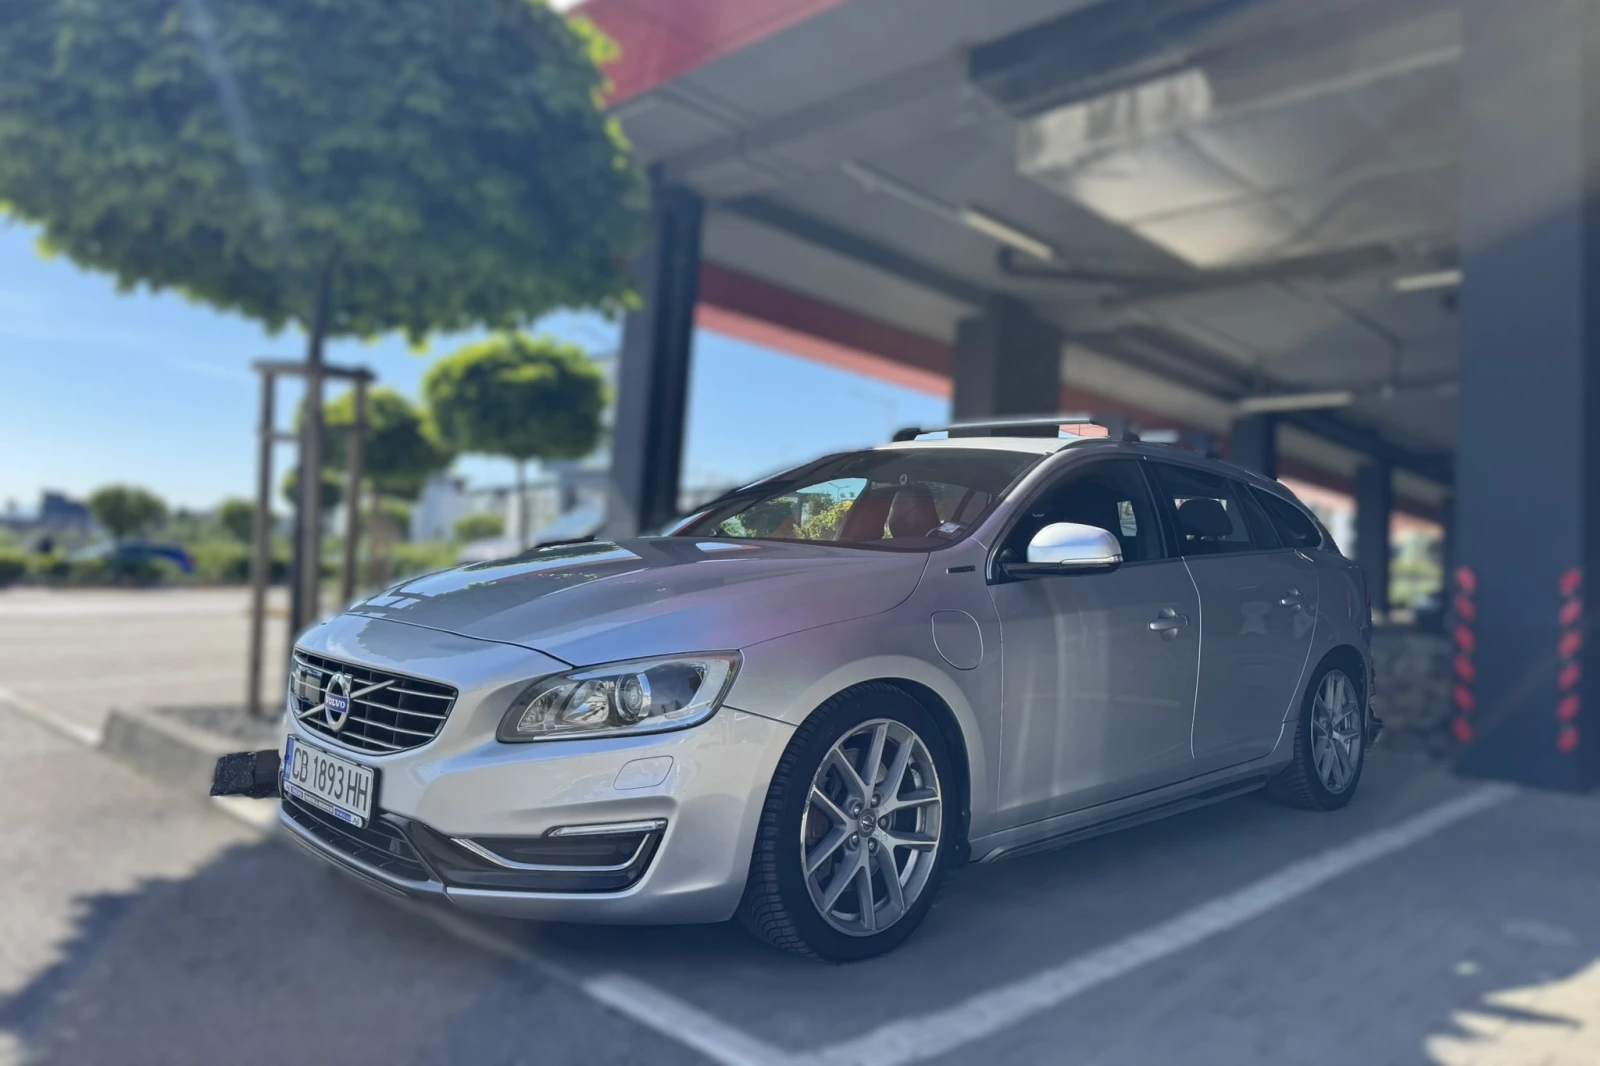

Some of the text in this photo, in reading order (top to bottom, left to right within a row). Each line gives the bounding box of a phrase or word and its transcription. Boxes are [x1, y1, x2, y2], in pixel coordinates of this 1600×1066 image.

[325, 696, 346, 709] VOLVO
[293, 747, 309, 783] CB
[313, 755, 345, 800] 1893
[346, 769, 369, 812] HH
